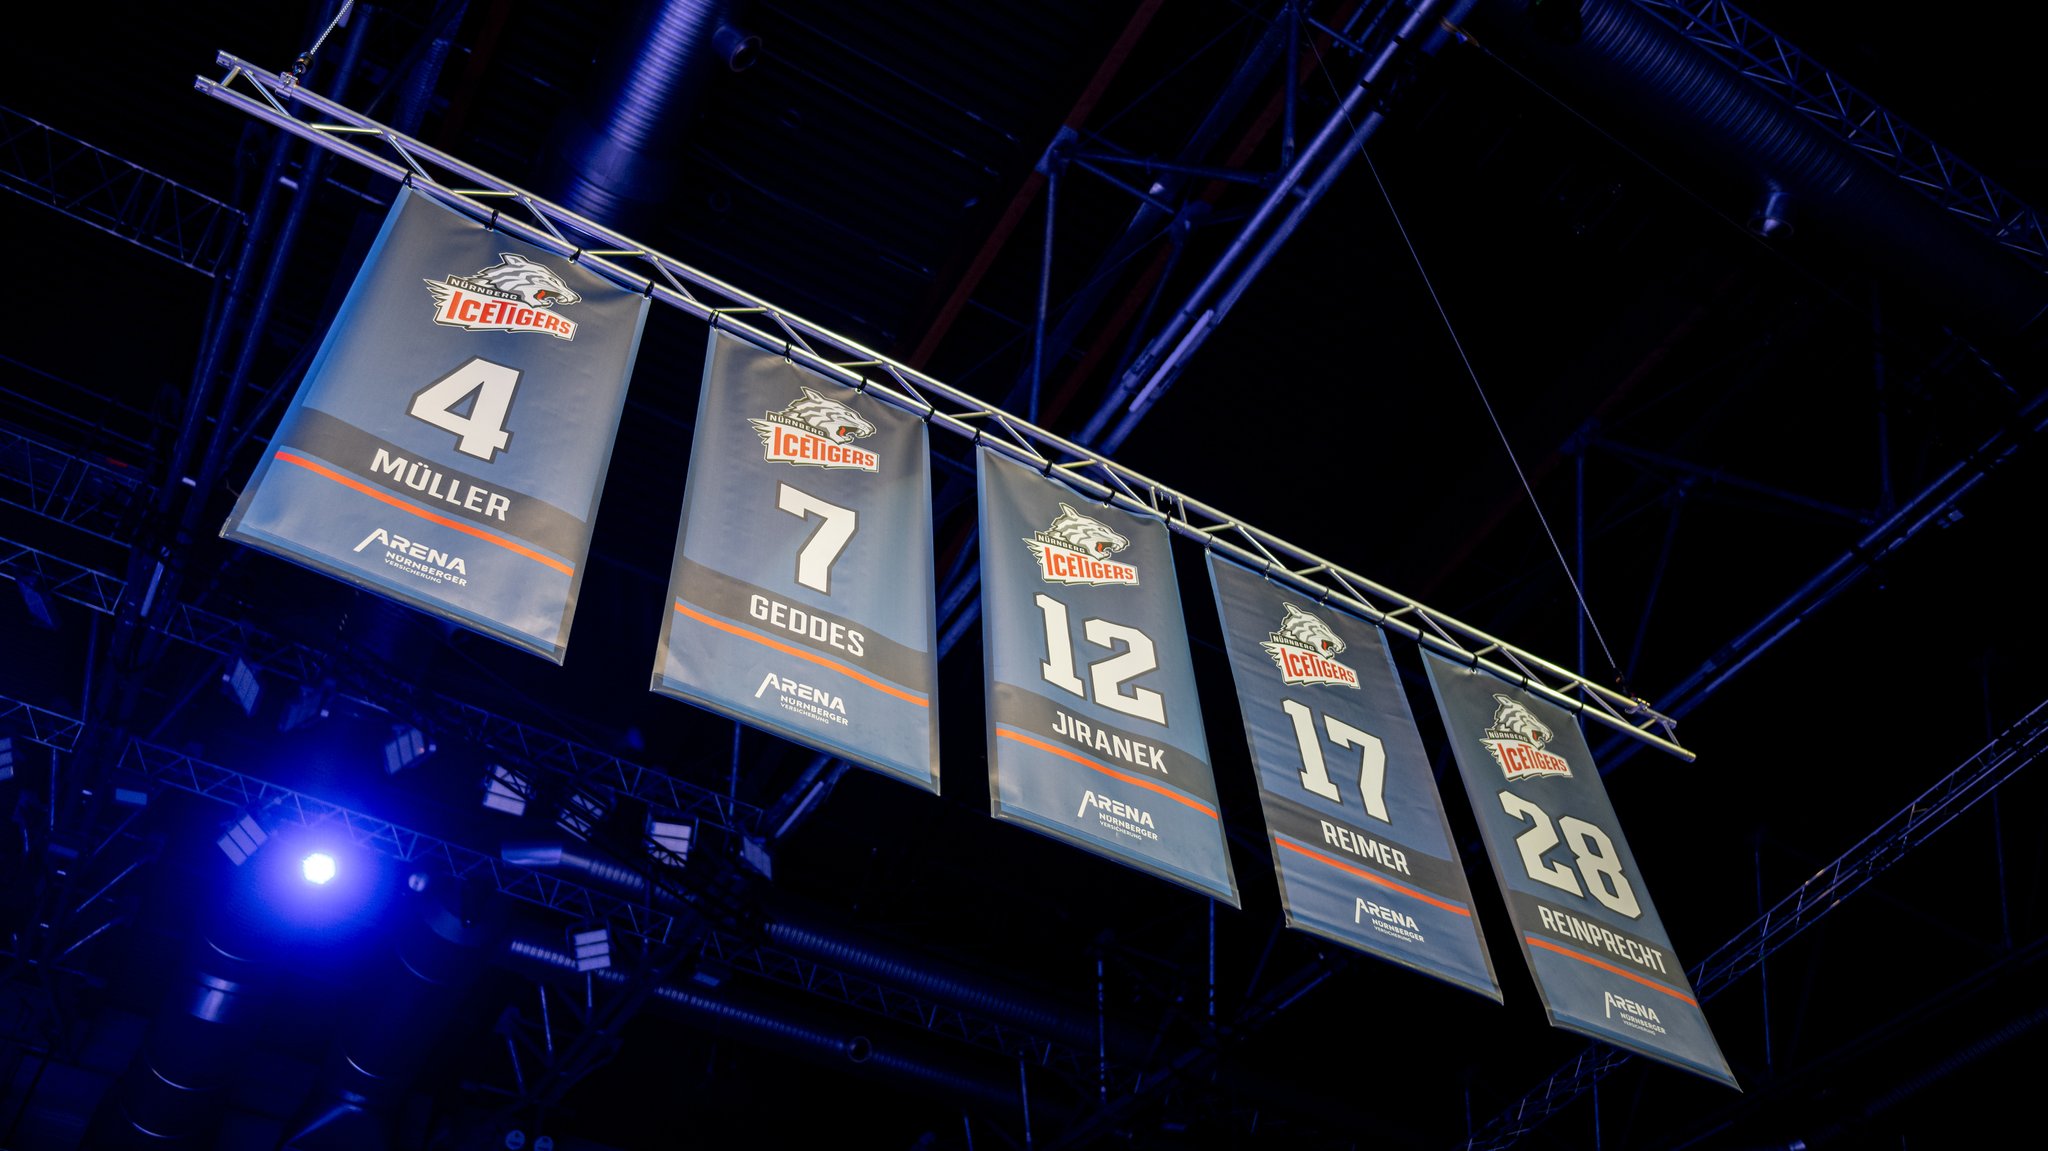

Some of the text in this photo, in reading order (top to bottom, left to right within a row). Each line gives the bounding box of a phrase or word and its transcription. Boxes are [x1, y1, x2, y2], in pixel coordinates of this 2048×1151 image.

[450, 278, 518, 300] NÜRNBERG
[446, 290, 571, 335] ICETIGERS
[408, 357, 522, 462] 4
[769, 413, 824, 436] NÜRNBERG
[773, 426, 874, 467] ICETIGERS
[370, 448, 510, 521] MÜLLER
[353, 528, 466, 575] ARENA
[777, 482, 857, 594] 7
[1038, 534, 1086, 554] NÜRNBERG
[384, 558, 442, 584] VERSICHERUNG
[386, 551, 467, 587] NÜRNBERGER
[1044, 546, 1133, 580] ICETIGERS
[750, 594, 865, 657] GEDDES
[1035, 593, 1167, 725] 12
[1280, 647, 1355, 683] ICETIGERS
[755, 672, 846, 714] ARENA
[780, 695, 849, 726] NÜRNBERGER
[780, 702, 829, 724] VERSICHERUNG
[1052, 711, 1168, 774] JIRANEK
[1497, 743, 1567, 774] ICETIGERS
[1282, 699, 1390, 823] 17
[1077, 790, 1155, 829] ARENA
[1099, 813, 1158, 841] NÜRNBERGER
[1100, 821, 1142, 840] VERSICHERUNG
[1320, 820, 1411, 876] REIMER
[1498, 790, 1642, 919] 28
[1354, 897, 1420, 932] ARENA
[1371, 918, 1425, 943] NÜRNBERGER
[1537, 905, 1667, 974] REINPRECHT
[1604, 991, 1660, 1024] ARENA
[1620, 1012, 1666, 1035] NÜRNBERGER
